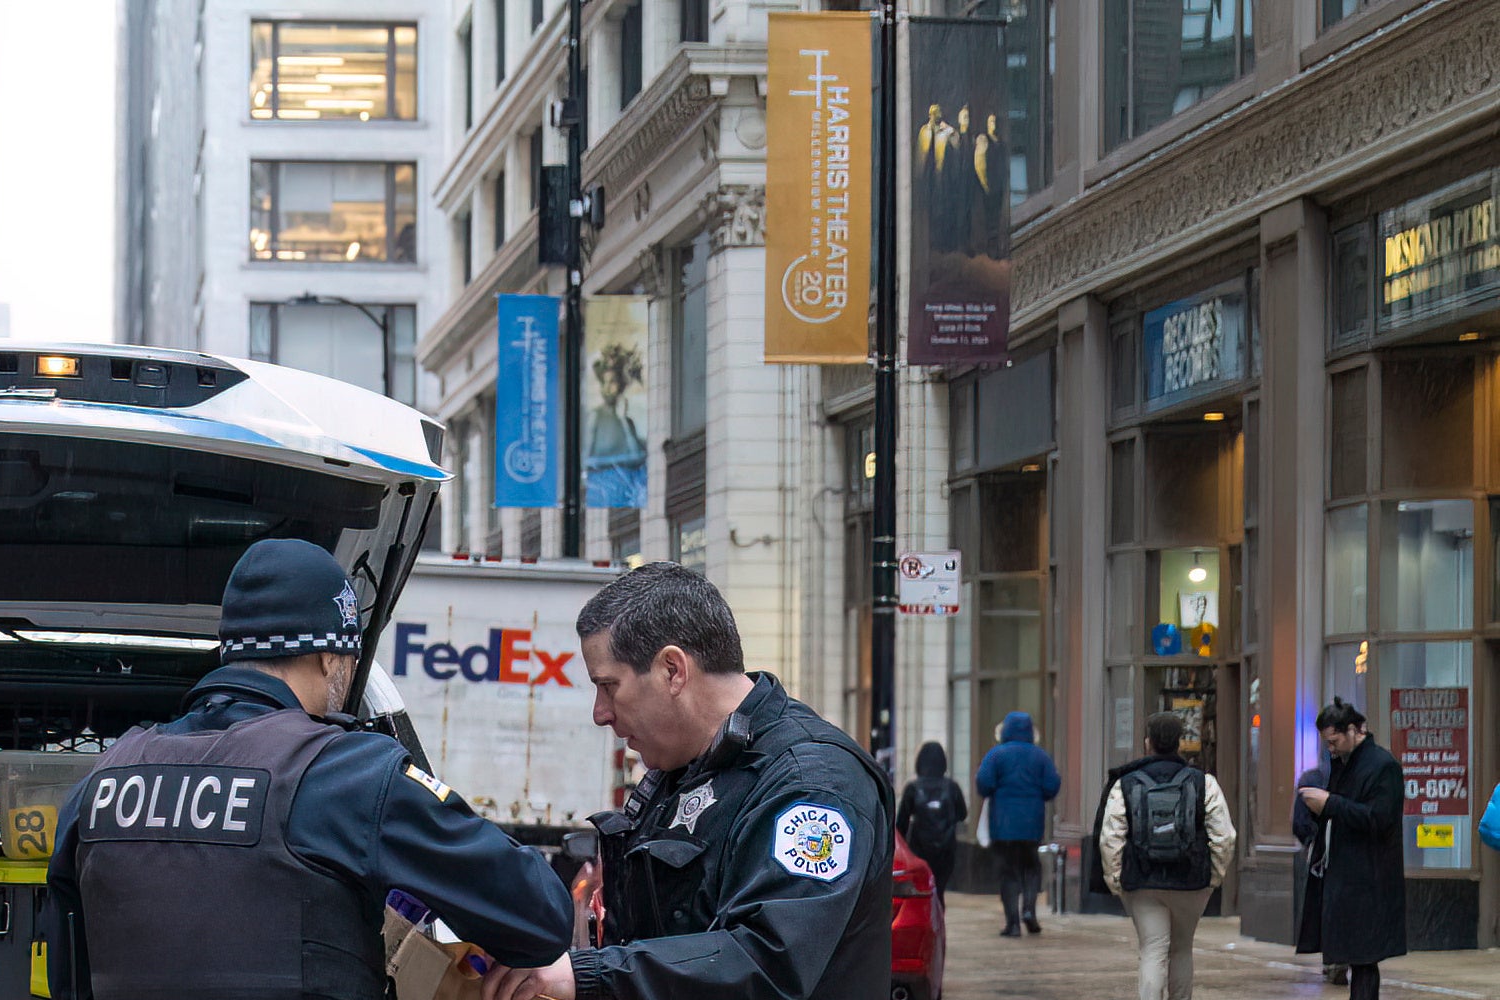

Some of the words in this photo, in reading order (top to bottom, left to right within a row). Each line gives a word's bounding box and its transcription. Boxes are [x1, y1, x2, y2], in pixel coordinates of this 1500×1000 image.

[826, 86, 849, 190] HARRIS
[825, 194, 848, 308] THEATER
[802, 270, 822, 306] 20
[393, 622, 575, 688] FedEx
[89, 775, 256, 832] POLICE
[783, 809, 845, 845] CHICAGO
[14, 811, 48, 855] 28
[784, 847, 838, 875] POLICE
